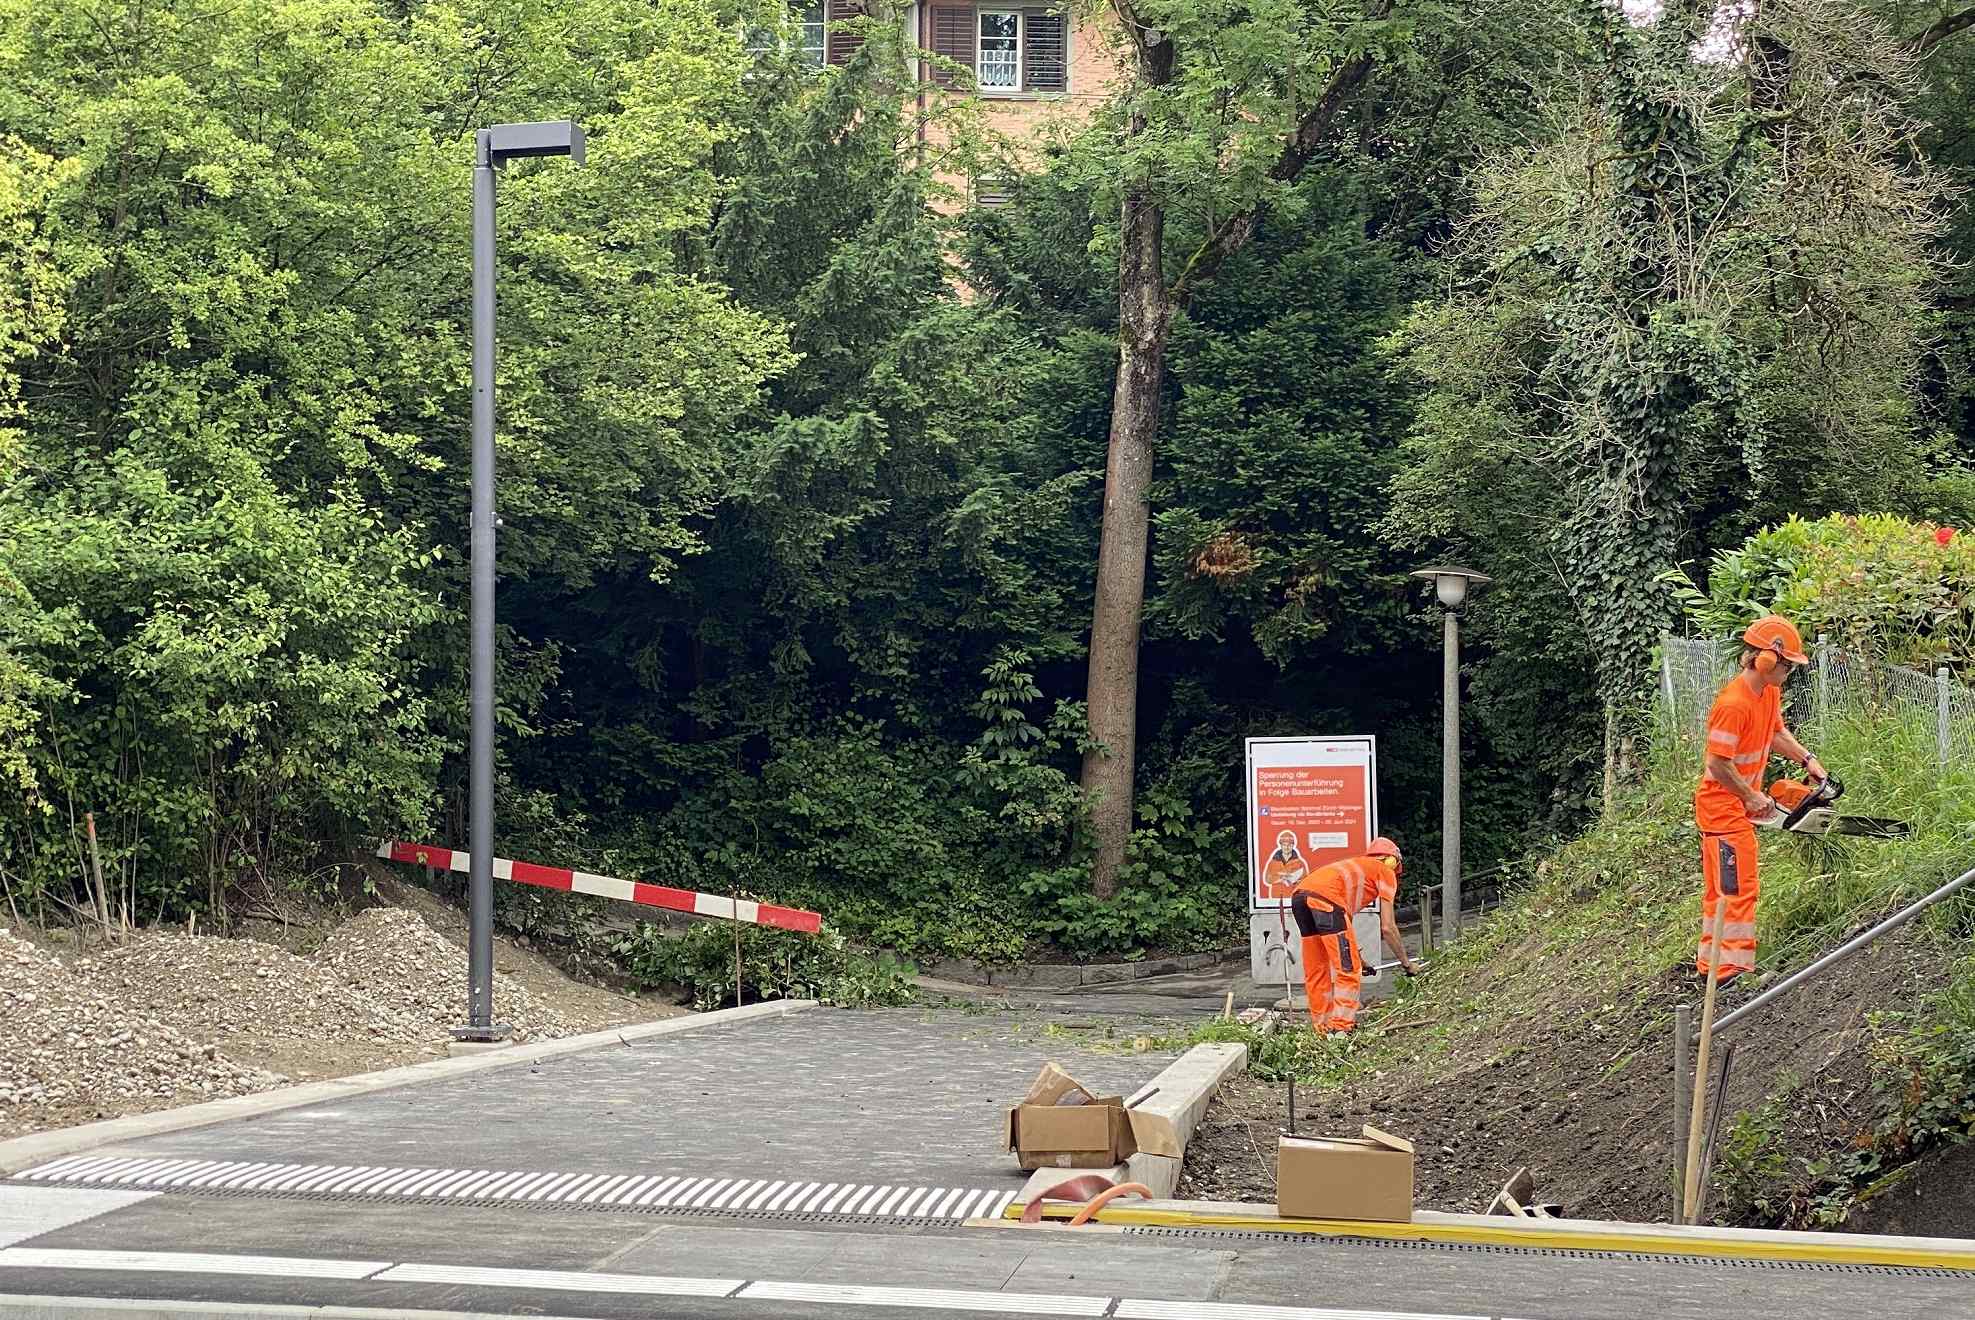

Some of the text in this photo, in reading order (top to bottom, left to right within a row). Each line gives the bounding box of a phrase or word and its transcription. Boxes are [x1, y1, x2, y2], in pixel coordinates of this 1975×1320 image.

[1258, 771, 1309, 780] Sperrung der
[1268, 788, 1290, 797] Folge
